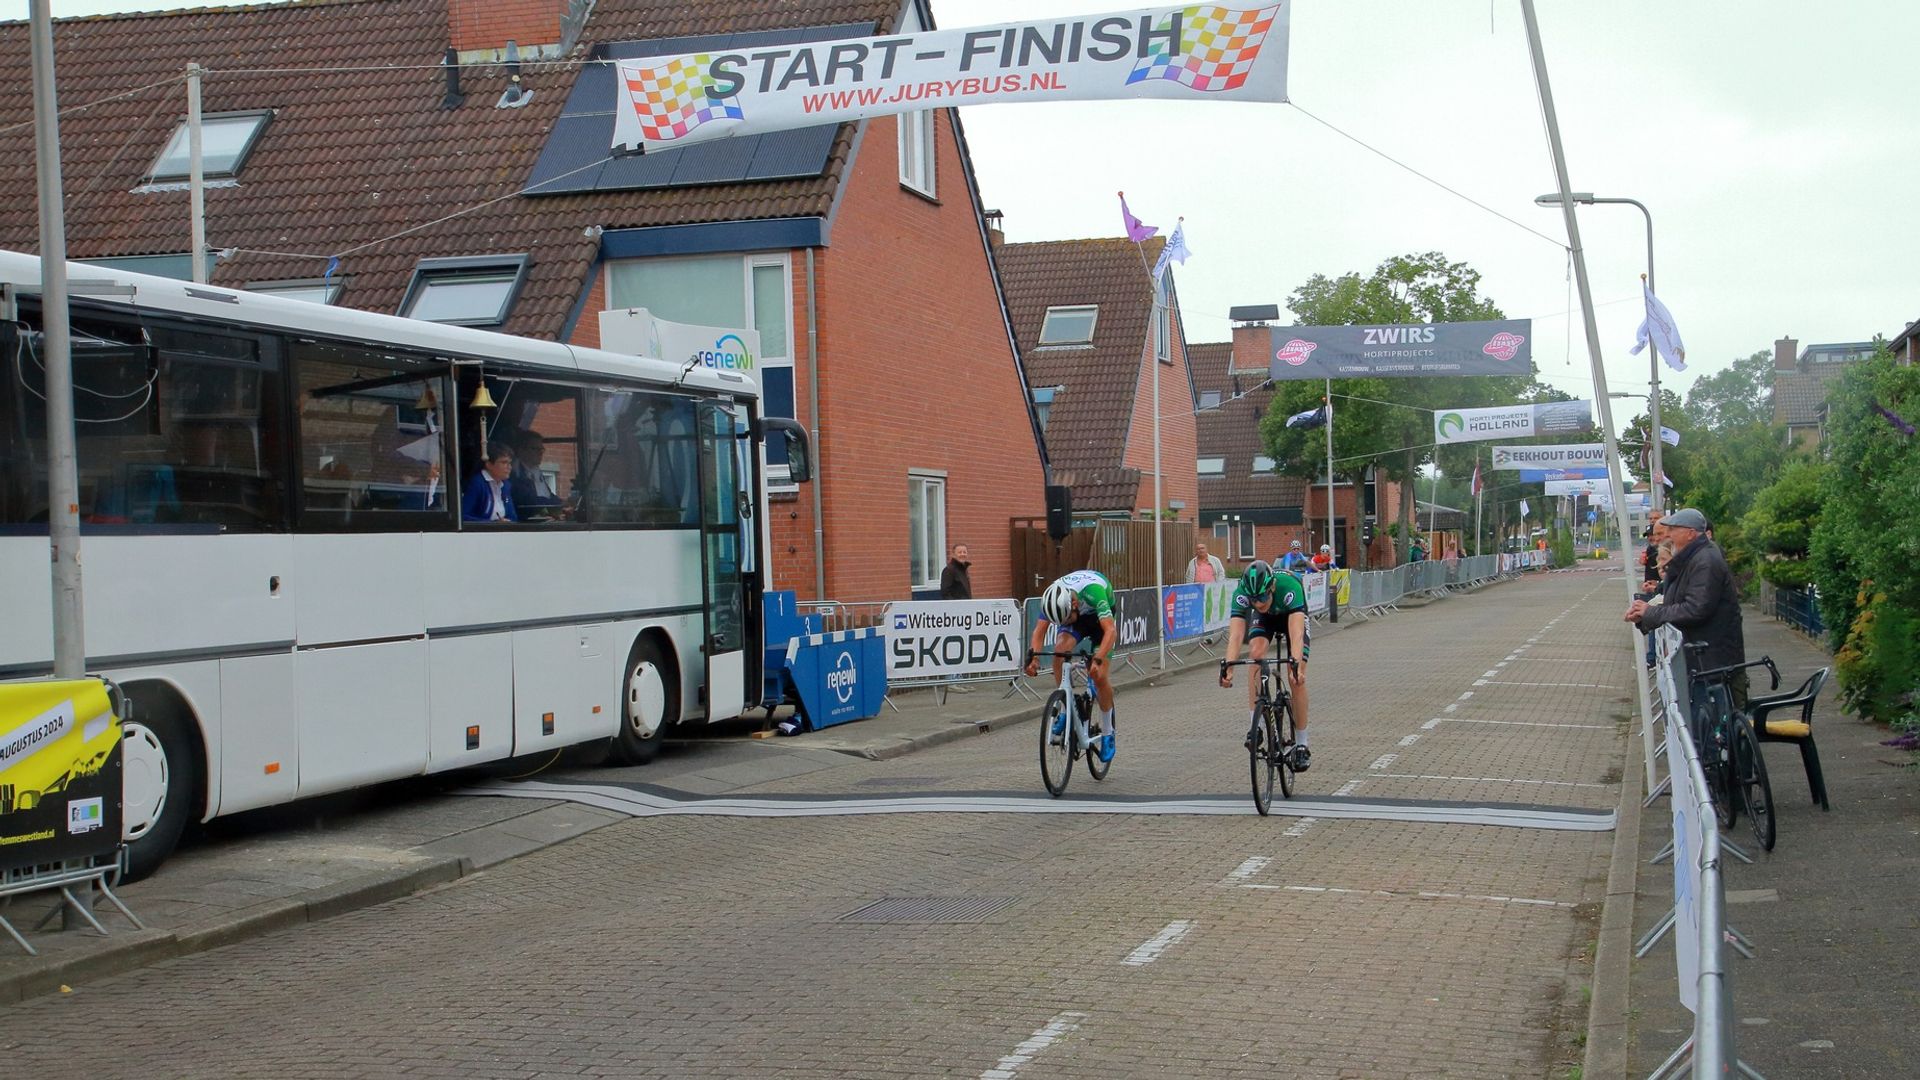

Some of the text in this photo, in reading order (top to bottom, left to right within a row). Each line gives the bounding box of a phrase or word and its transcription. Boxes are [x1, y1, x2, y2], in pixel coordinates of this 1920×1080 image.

[802, 73, 1067, 113] WWW.JURYBUS.NL
[1363, 327, 1435, 345] ZWIRS
[698, 350, 754, 370] renewi
[1363, 349, 1434, 358] HORTIPROJECTS
[1469, 418, 1529, 432] HOLLAND
[1512, 449, 1604, 462] EEKHOUT BOUW
[778, 593, 783, 617] 1
[908, 611, 1012, 630] Wittebrug De Lier
[827, 667, 857, 689] renewi
[43, 715, 64, 738] 2024
